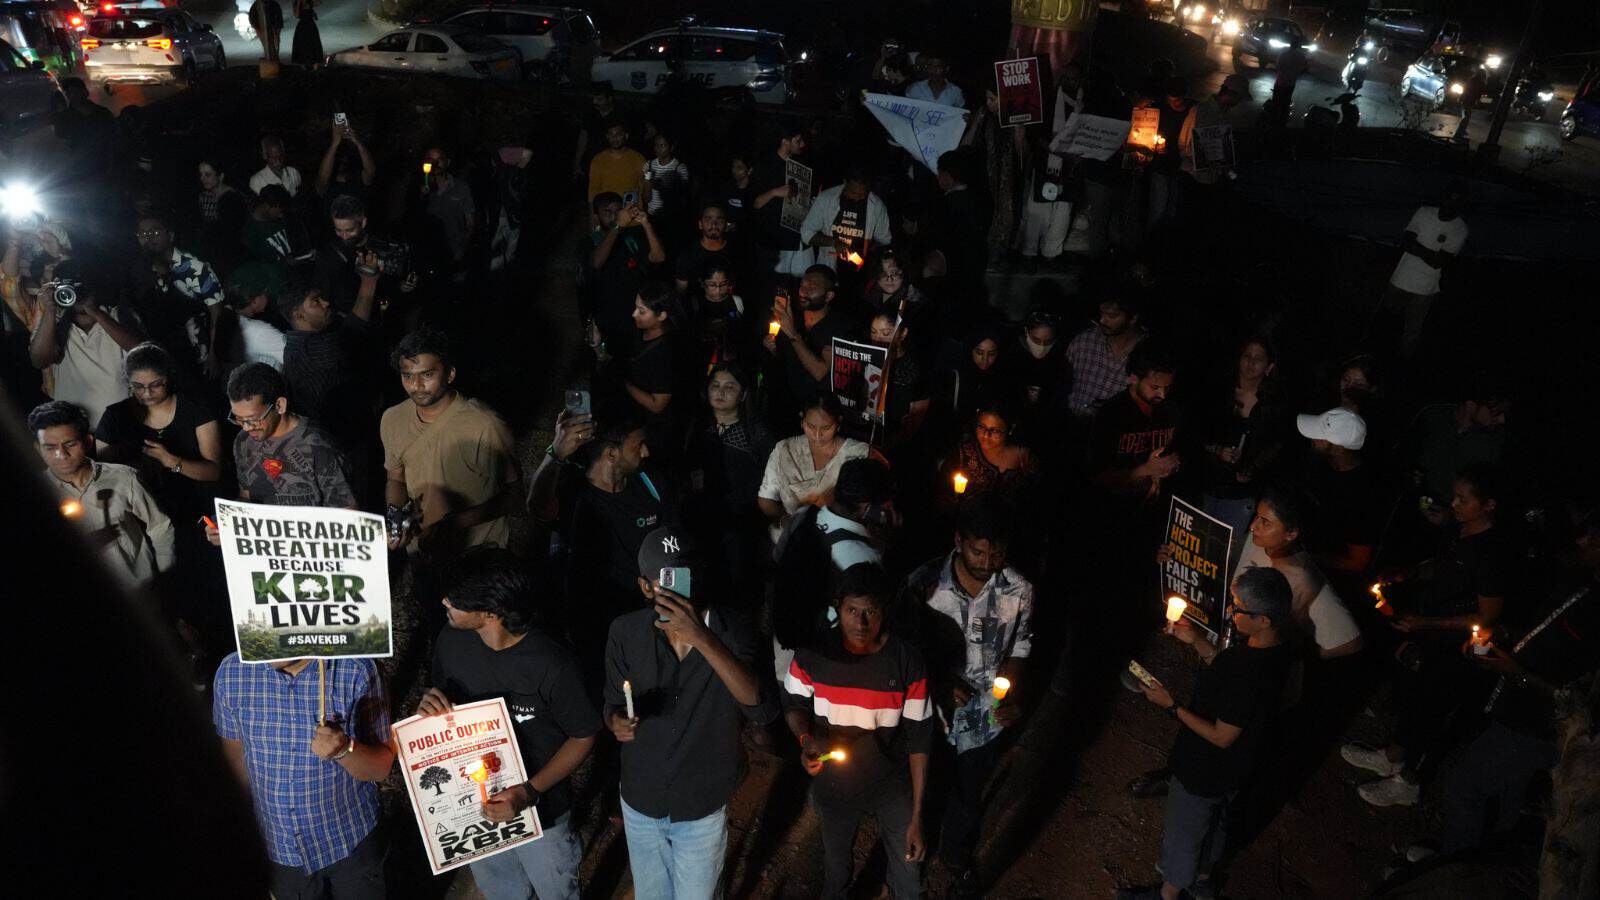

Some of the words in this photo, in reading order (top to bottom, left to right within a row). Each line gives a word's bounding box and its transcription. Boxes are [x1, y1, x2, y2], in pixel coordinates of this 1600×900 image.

[655, 73, 715, 87] PICE
[1002, 62, 1028, 76] STOP
[1002, 73, 1031, 87] WORK
[843, 210, 858, 219] LIFE
[831, 225, 864, 238] POWER
[835, 346, 852, 359] WHERE
[853, 352, 859, 360] IS
[860, 353, 872, 362] THE
[232, 515, 375, 543] HYDERABAD
[1173, 507, 1194, 531] THE
[236, 537, 372, 561] BREATHES
[661, 535, 680, 553] NY
[1171, 524, 1200, 552] HCITI
[269, 558, 344, 572] BECAUSE
[1166, 559, 1199, 587] FAILS
[1168, 542, 1219, 580] PROJECT
[251, 571, 366, 604] KBR
[1166, 573, 1188, 597] THE
[270, 604, 361, 628] LIVES
[287, 634, 348, 645] #SAVEKBR
[408, 729, 453, 753] PUBLIC
[456, 719, 501, 738] OUTCRY
[418, 757, 440, 768] NOTICE
[450, 746, 479, 758] INTENDED
[479, 740, 502, 749] ACTION
[443, 822, 527, 860] KBR
